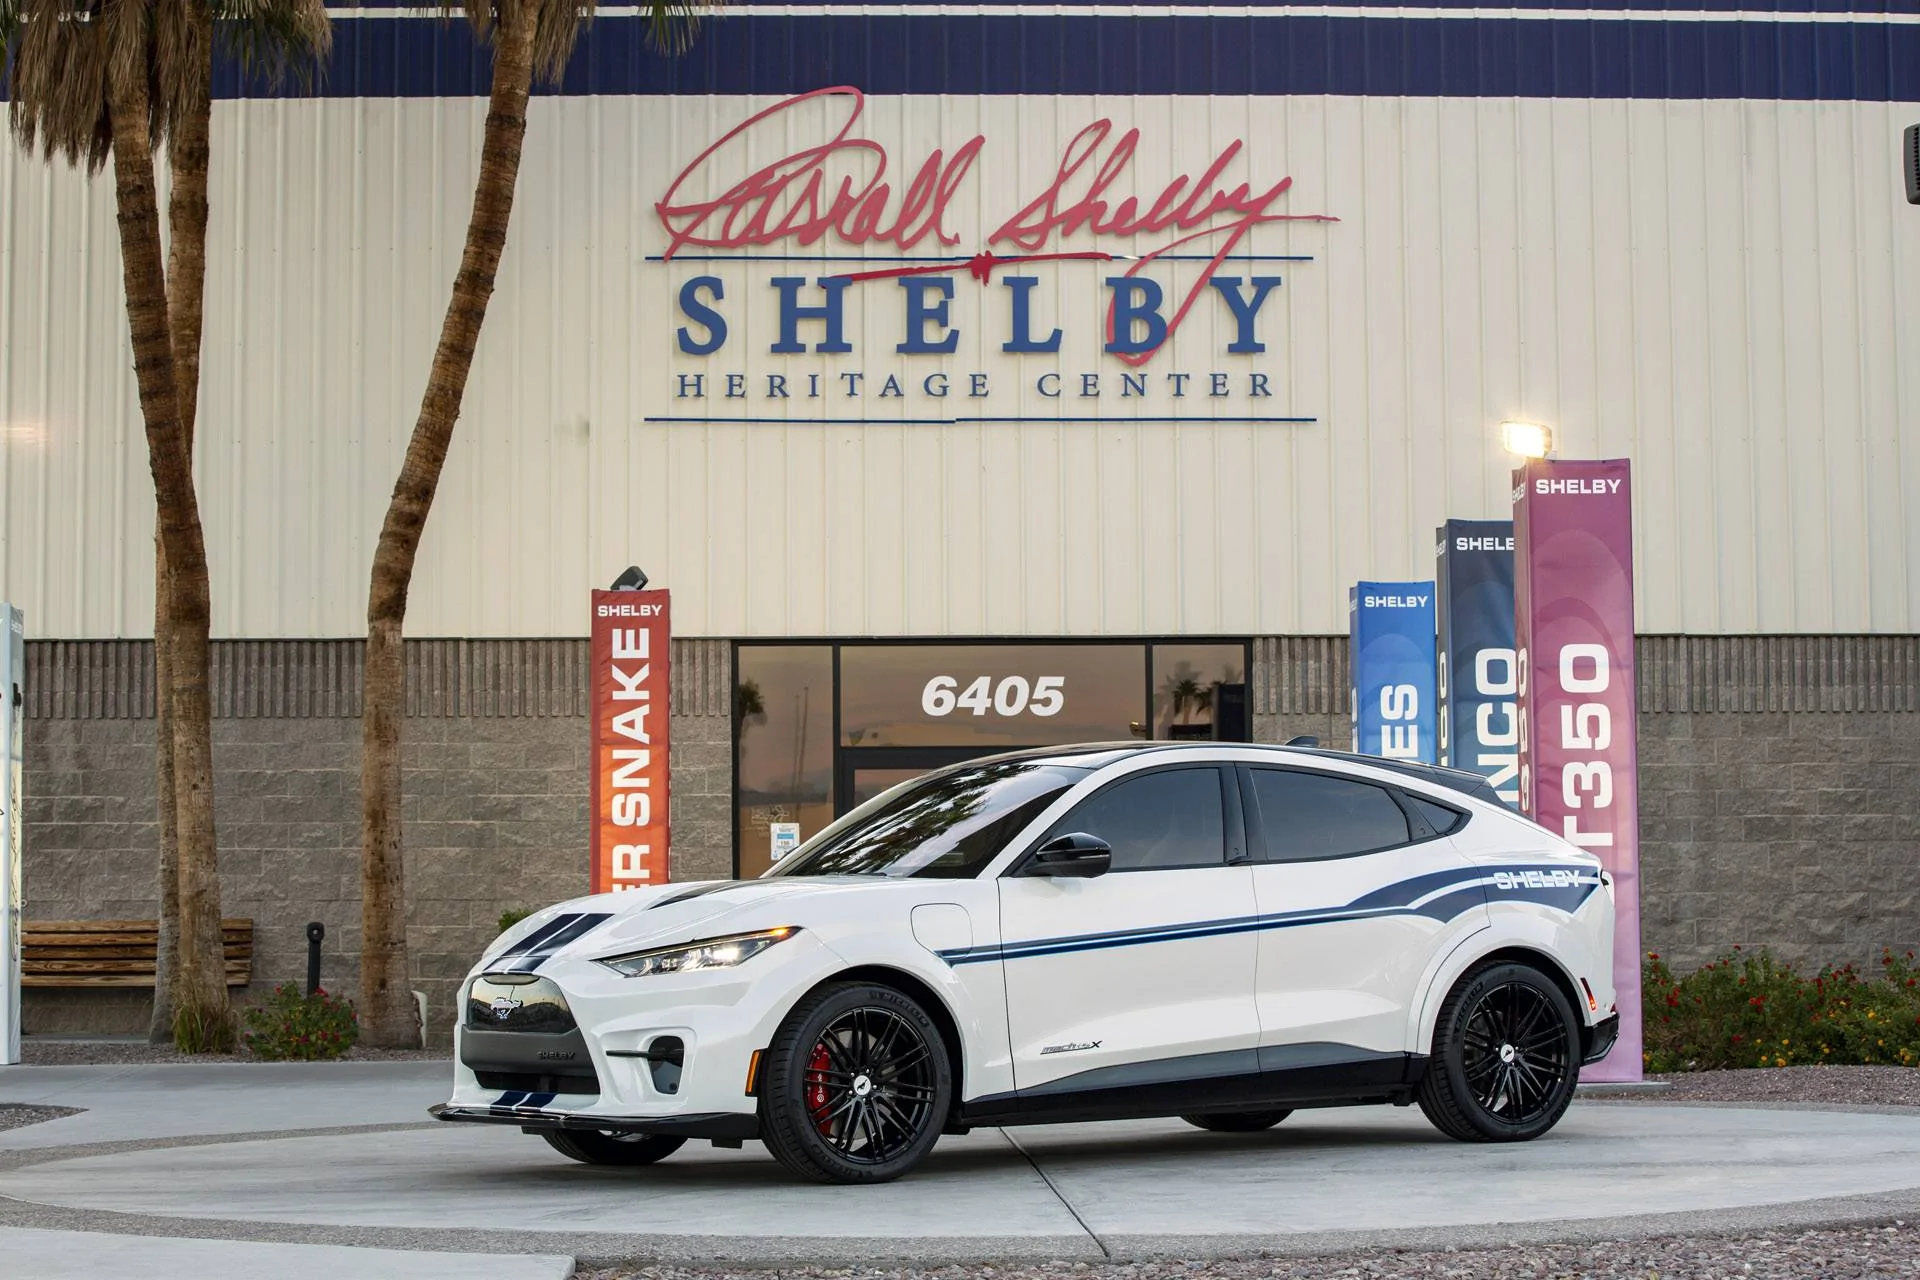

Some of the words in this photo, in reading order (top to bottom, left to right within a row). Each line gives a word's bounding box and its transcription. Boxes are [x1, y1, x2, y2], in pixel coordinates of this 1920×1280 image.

[677, 276, 1281, 355] SHELBY
[677, 373, 989, 398] HERITAGE
[1037, 373, 1272, 397] CENTER
[1535, 479, 1621, 494] SHELBY
[598, 605, 662, 617] SHELBY
[1364, 595, 1428, 608] SHELBY
[921, 675, 1065, 717] 6405
[612, 628, 650, 827] SNAKE
[1559, 643, 1613, 846] T350
[612, 845, 650, 893] R
[1494, 870, 1580, 889] SHELBY
